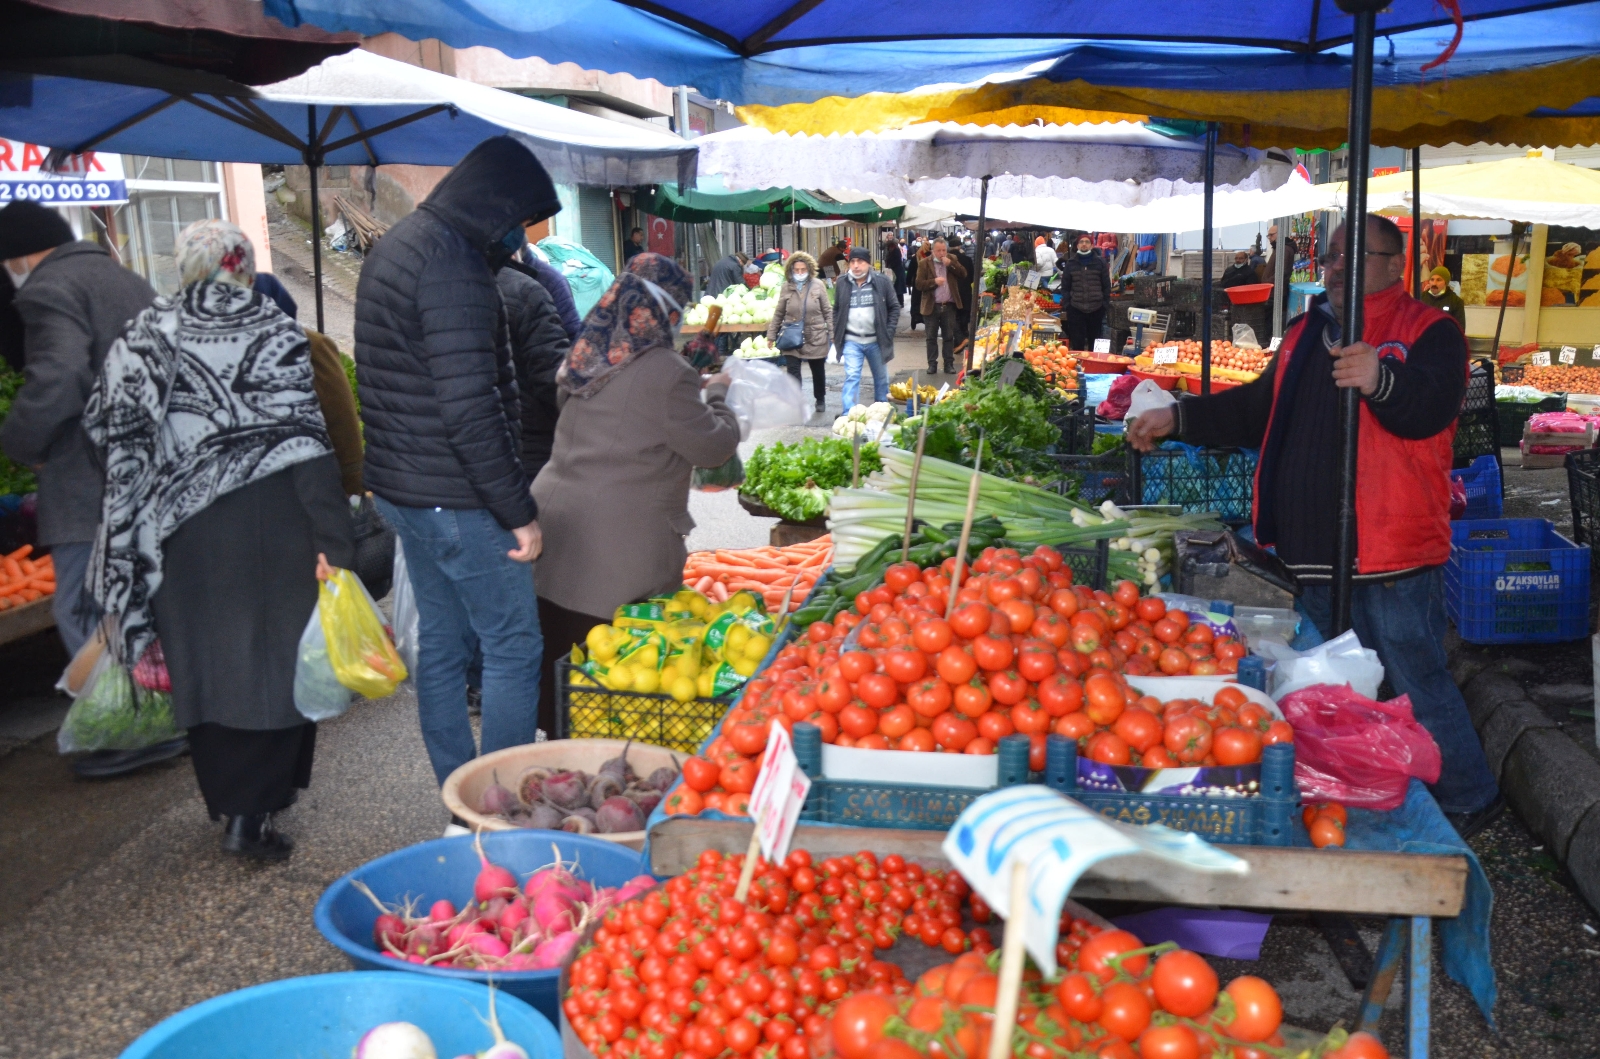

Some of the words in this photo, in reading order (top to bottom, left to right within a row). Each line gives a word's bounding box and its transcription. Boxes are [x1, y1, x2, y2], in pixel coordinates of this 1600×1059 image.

[15, 184, 55, 200] 600
[58, 184, 83, 199] 00
[86, 183, 110, 198] 30
